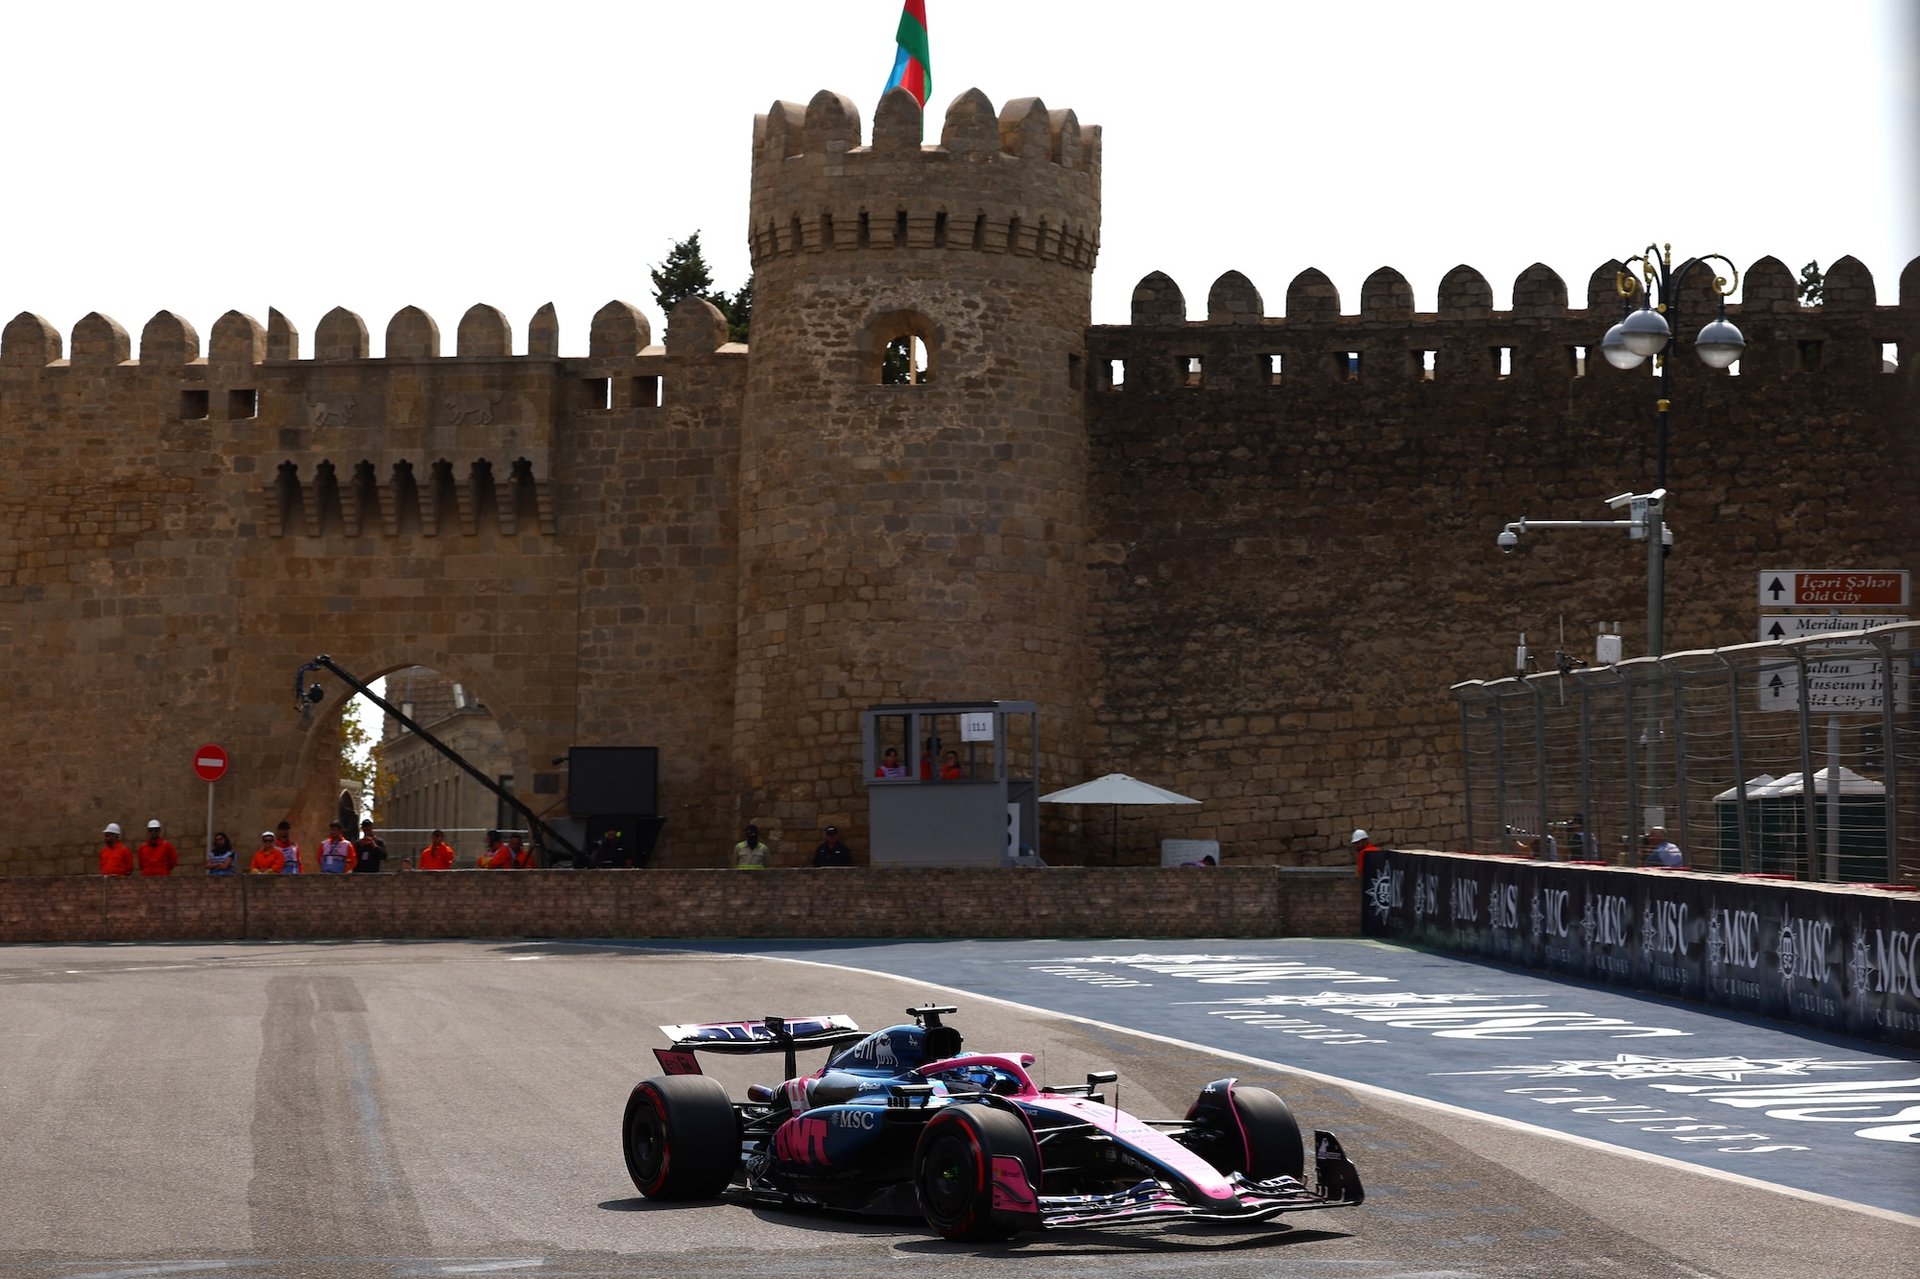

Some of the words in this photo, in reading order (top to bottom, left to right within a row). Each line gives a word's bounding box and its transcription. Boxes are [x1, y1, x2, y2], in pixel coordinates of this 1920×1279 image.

[1801, 574, 1841, 591] İçəri
[1846, 576, 1895, 591] Şəhər
[1802, 591, 1830, 602] Old
[1832, 591, 1861, 604] City
[1796, 618, 1858, 630] Meridian
[1803, 662, 1849, 674] ultan
[1832, 695, 1866, 710] City
[1595, 894, 1628, 947] MSC
[1656, 899, 1689, 956] MSC
[1723, 909, 1760, 969] MSC
[1798, 918, 1832, 984] MSC
[1875, 929, 1920, 998] MSC
[840, 1110, 874, 1130] MSC
